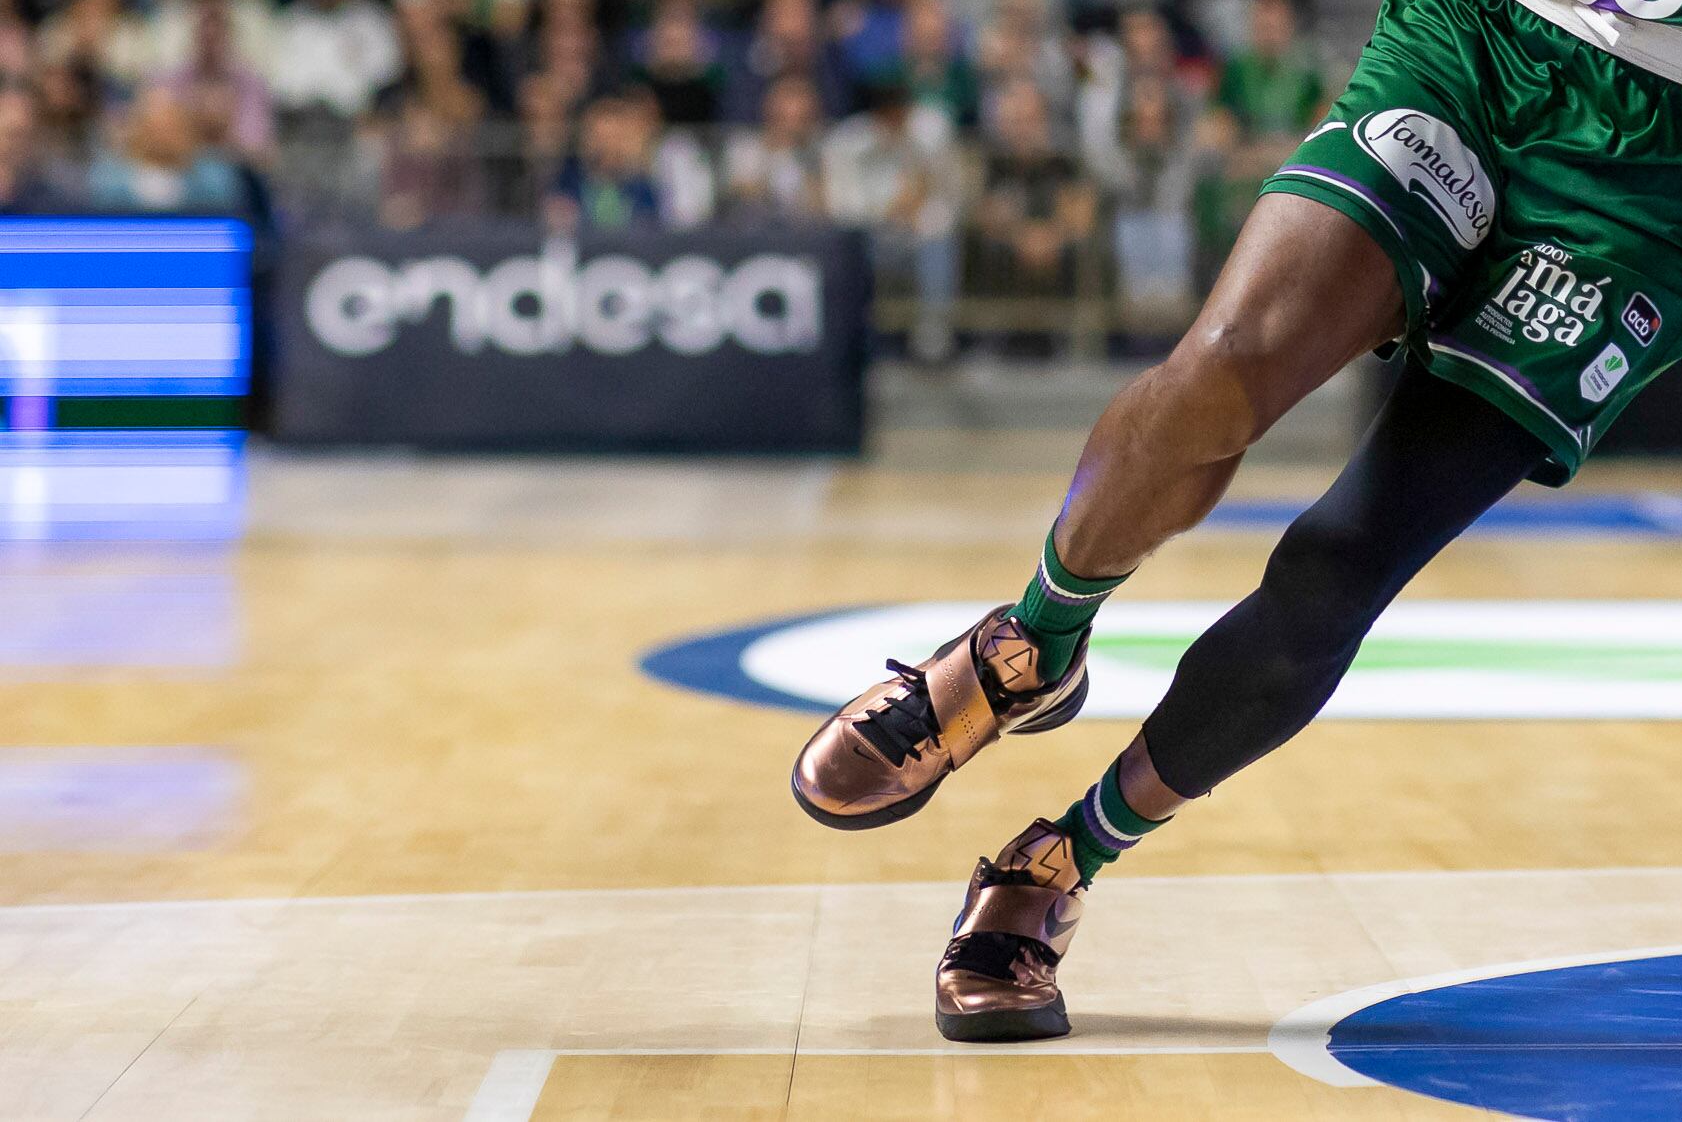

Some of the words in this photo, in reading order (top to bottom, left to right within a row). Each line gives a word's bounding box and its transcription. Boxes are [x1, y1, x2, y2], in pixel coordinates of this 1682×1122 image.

[1368, 114, 1489, 238] famadesa
[306, 228, 822, 356] endesa
[1520, 249, 1535, 267] a
[1524, 255, 1612, 322] má
[1491, 265, 1585, 347] laga
[1627, 308, 1650, 337] acb
